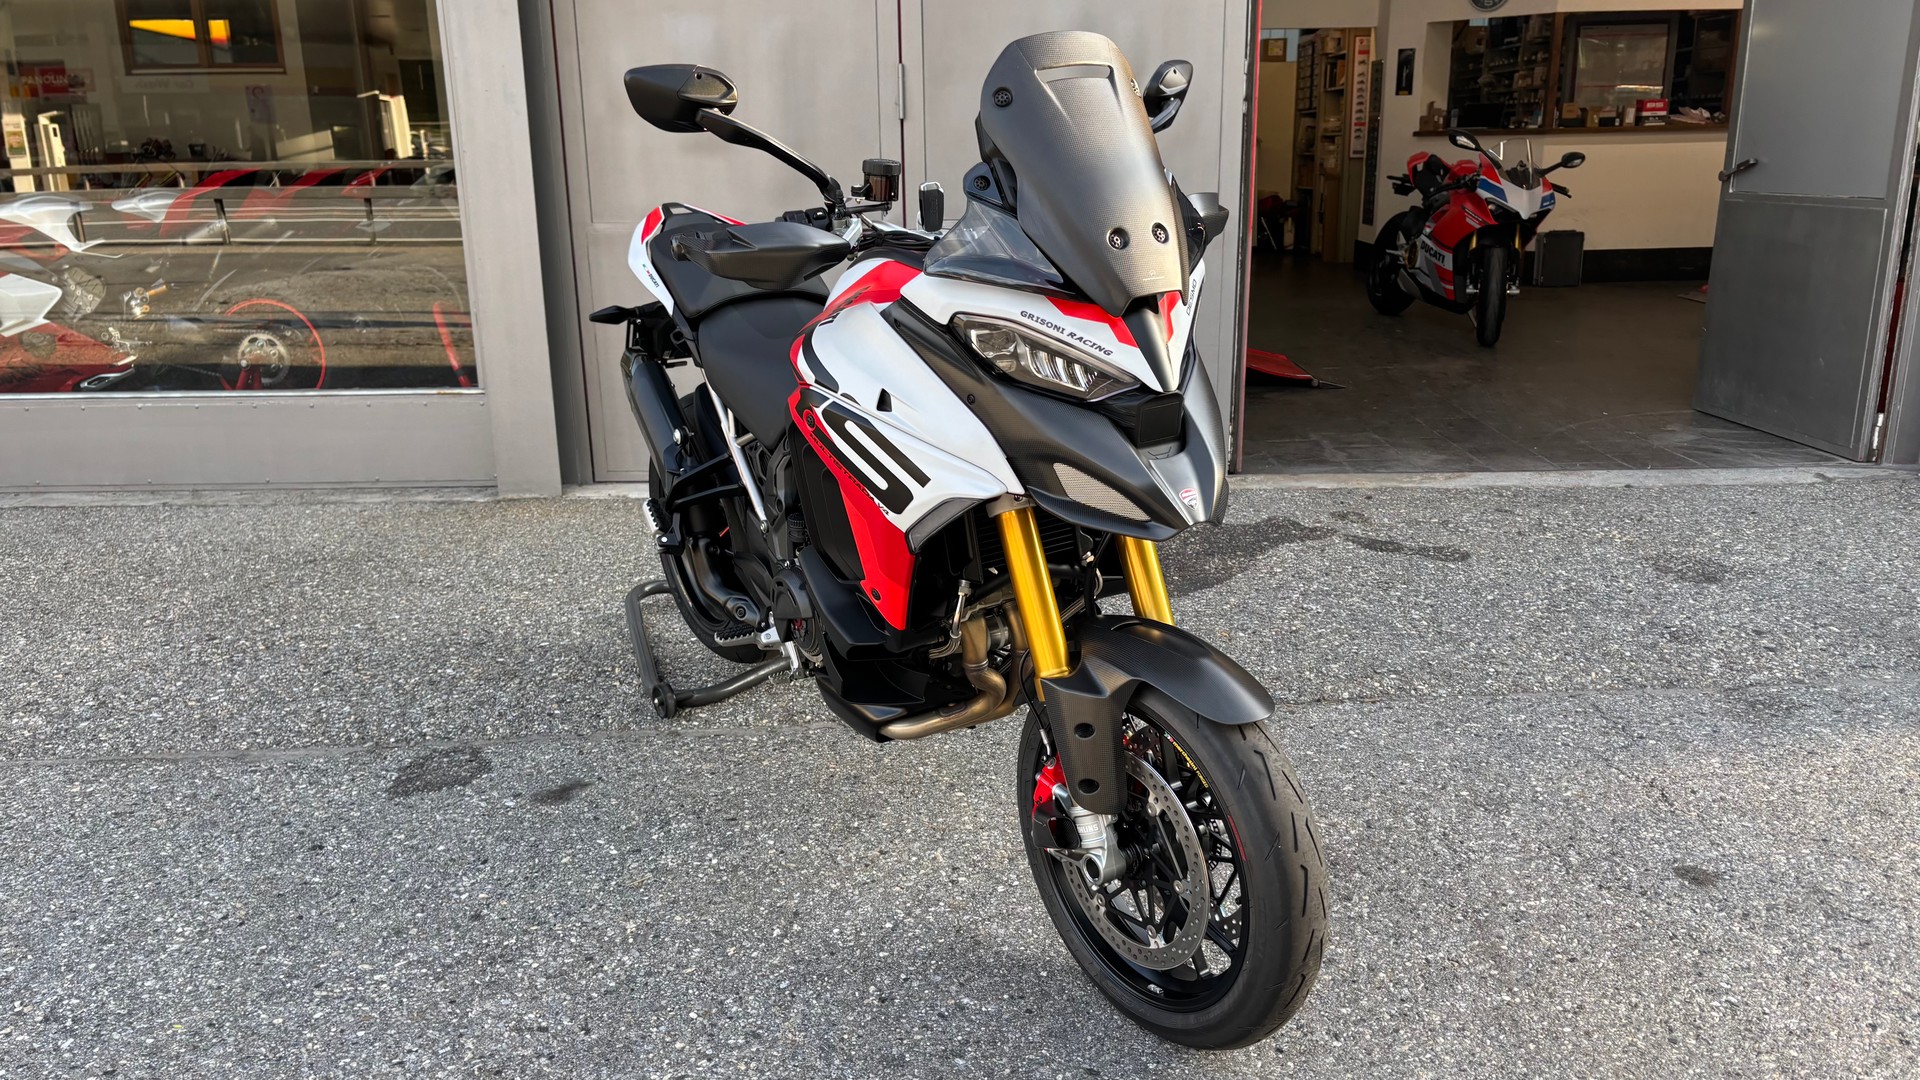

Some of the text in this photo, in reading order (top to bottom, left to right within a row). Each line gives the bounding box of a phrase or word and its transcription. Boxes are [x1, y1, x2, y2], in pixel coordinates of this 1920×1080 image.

[1420, 240, 1445, 264] DUCATI
[648, 273, 660, 288] DUCATI
[1020, 310, 1114, 356] GRISONI RACING
[809, 433, 890, 516] MULTISTRADA V4
